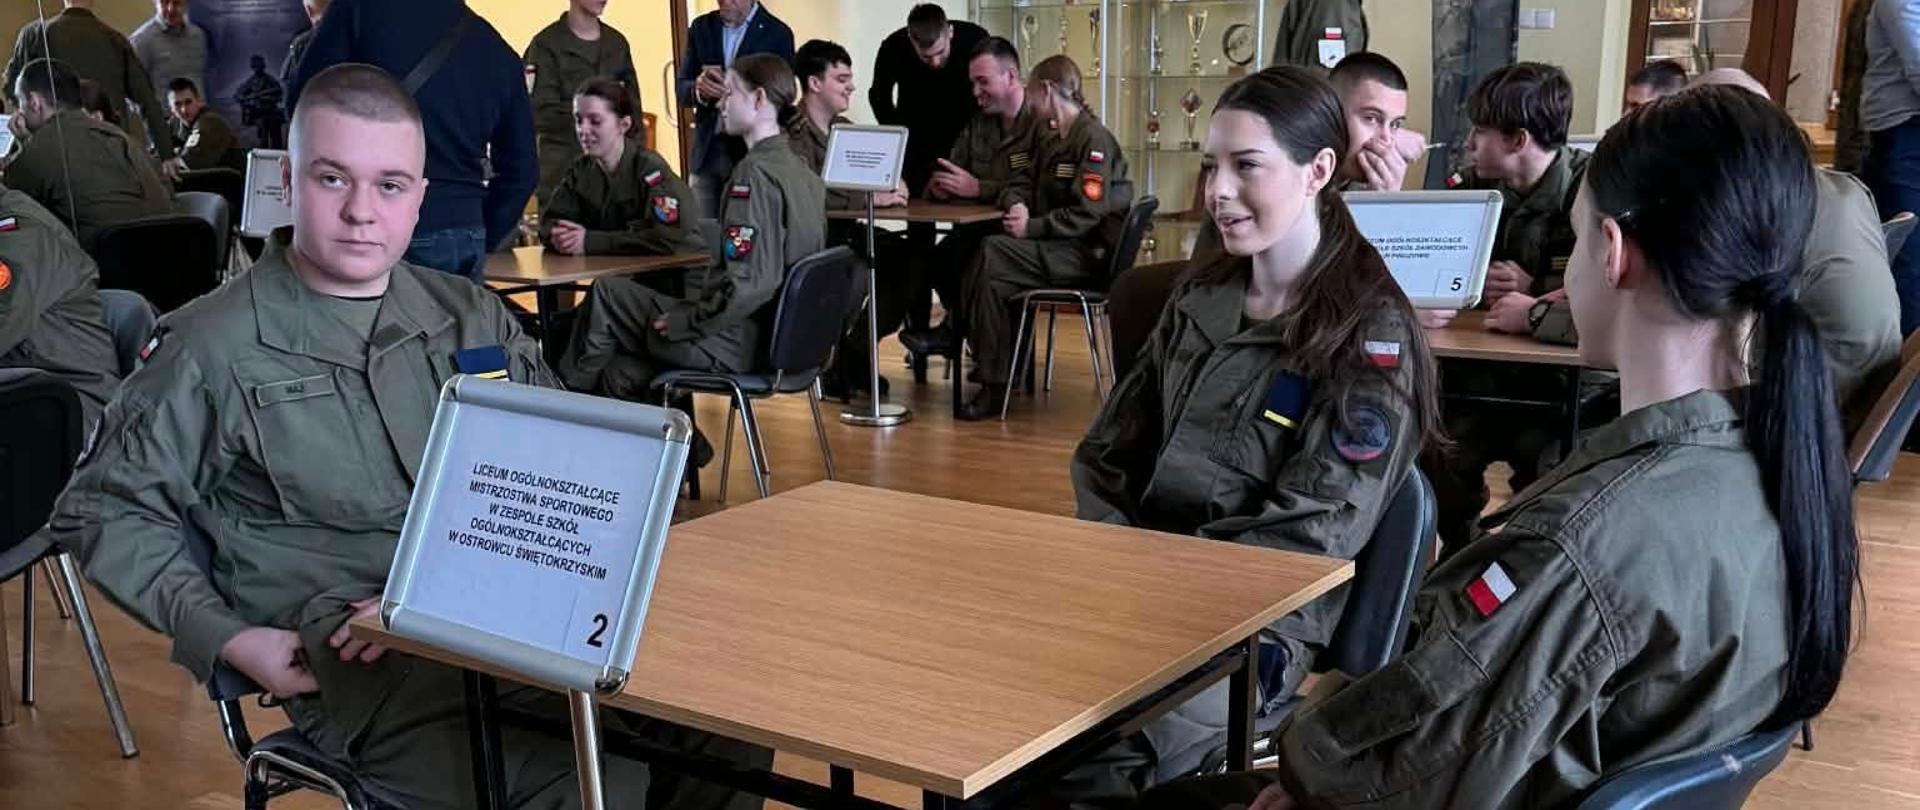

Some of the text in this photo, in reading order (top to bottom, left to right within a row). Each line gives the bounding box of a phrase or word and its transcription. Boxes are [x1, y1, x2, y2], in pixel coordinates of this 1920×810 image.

[1450, 277, 1463, 291] 5
[469, 480, 614, 522] MISTRZOSTWA SPORTOWEGO
[473, 463, 620, 505] LICEUM OGÓLNOKSZTAŁCĄCE
[470, 517, 592, 556] OGÓLNOKSZTAŁCĄCYCH
[489, 503, 580, 535] W ZESPOLE SZKÓŁ
[448, 529, 607, 580] W OSTROWCU ŚWIĘTOKRZYSKIM
[586, 613, 609, 648] 2
